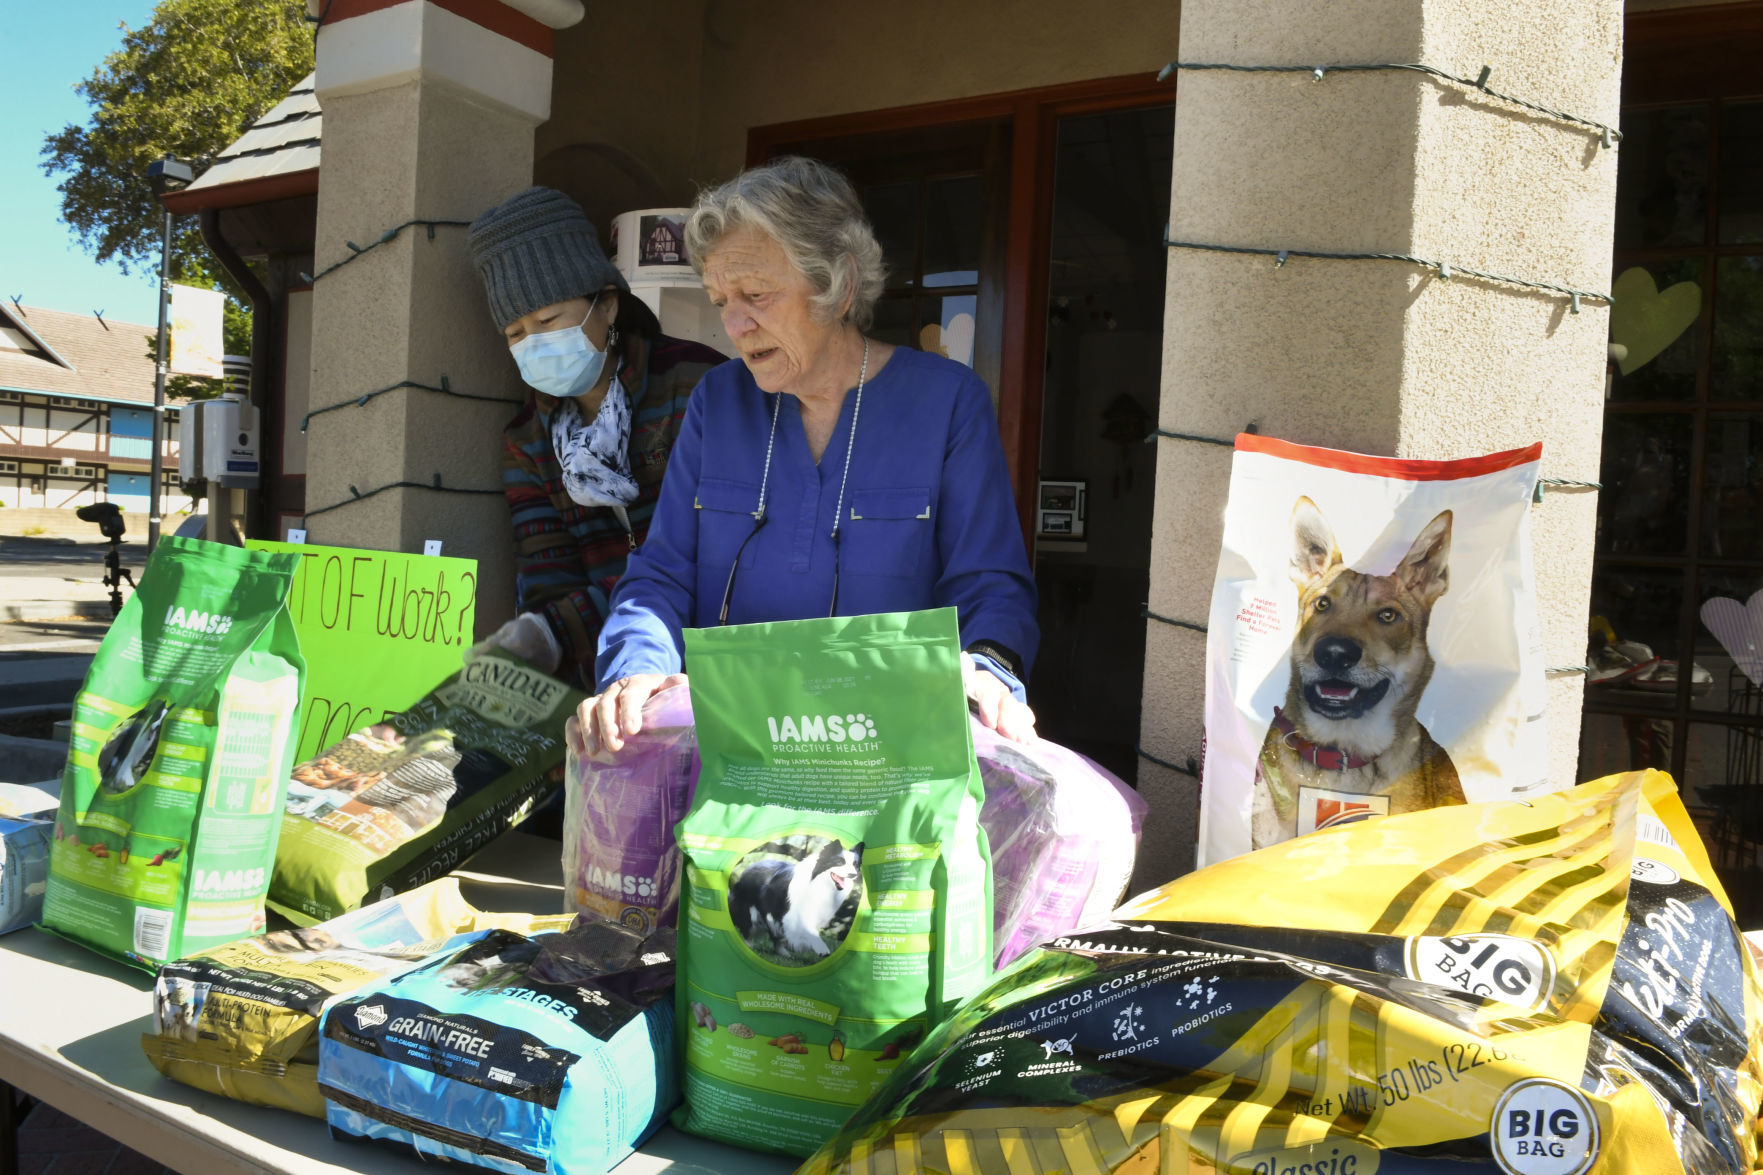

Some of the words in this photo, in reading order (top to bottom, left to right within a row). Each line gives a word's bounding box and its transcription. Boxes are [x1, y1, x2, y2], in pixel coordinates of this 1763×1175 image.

[321, 555, 372, 631] OF
[377, 560, 476, 646] Work?
[165, 605, 221, 634] IAMS
[1236, 614, 1251, 623] Find
[1242, 608, 1265, 618] Shelter
[466, 661, 556, 703] CANIDAE
[768, 715, 846, 743] IAMS
[772, 744, 832, 753] PROACTIVE
[835, 742, 879, 753] HEALTH
[773, 758, 790, 766] Why
[854, 757, 886, 767] Recipe?
[784, 802, 797, 812] for
[798, 804, 811, 812] the
[814, 806, 837, 815] IAMS
[838, 807, 880, 817] difference.
[885, 846, 914, 854] HEALTHY
[408, 847, 459, 889] RECIPE
[194, 868, 252, 892] IAMS
[586, 863, 637, 896] IAMS
[626, 895, 657, 905] HEALTH
[873, 935, 906, 944] HEALTHY
[873, 942, 897, 950] TEETH
[1435, 953, 1493, 996] BAG
[1439, 938, 1531, 996] BIG
[223, 986, 236, 996] FOR
[756, 993, 777, 1002] MADE
[778, 995, 797, 1004] WITH
[797, 998, 816, 1009] REAL
[501, 986, 578, 1021] STAGES
[742, 1000, 786, 1011] WHOLESOME
[786, 1003, 833, 1022] INGREDIENTS
[960, 1034, 1006, 1051] superior
[1007, 1011, 1070, 1040] digestibility
[1071, 1005, 1093, 1020] and
[1094, 985, 1139, 1010] immune
[1140, 968, 1182, 990] system
[978, 1017, 1027, 1038] essential
[1028, 989, 1093, 1022] VICTOR
[1098, 968, 1148, 996] CORE
[201, 1006, 242, 1023] FORMULA
[416, 1012, 443, 1024] DIAMOND
[444, 1020, 478, 1034] NATURALS
[1171, 1002, 1233, 1038] PROBIOTICS
[385, 1034, 419, 1050] WILD-CAUGHT
[1097, 1036, 1161, 1062] PREBIOTICS
[407, 1049, 430, 1061] FORMULA
[770, 1058, 779, 1066] OF
[780, 1060, 806, 1071] CARROTS
[825, 1063, 851, 1072] CHICKEN
[1016, 1065, 1083, 1079] COMPLEXES
[1027, 1060, 1076, 1072] MINERAL
[955, 1069, 1002, 1090] SELENIUM
[960, 1078, 992, 1094] YEAST
[1295, 1101, 1333, 1117] Net
[1338, 1090, 1376, 1116] Wt.
[1377, 1069, 1411, 1108] 50
[1411, 1058, 1444, 1095] lbs
[1508, 1108, 1579, 1139] BIG
[1516, 1139, 1566, 1159] BAG
[1253, 1148, 1358, 1175] Classic
